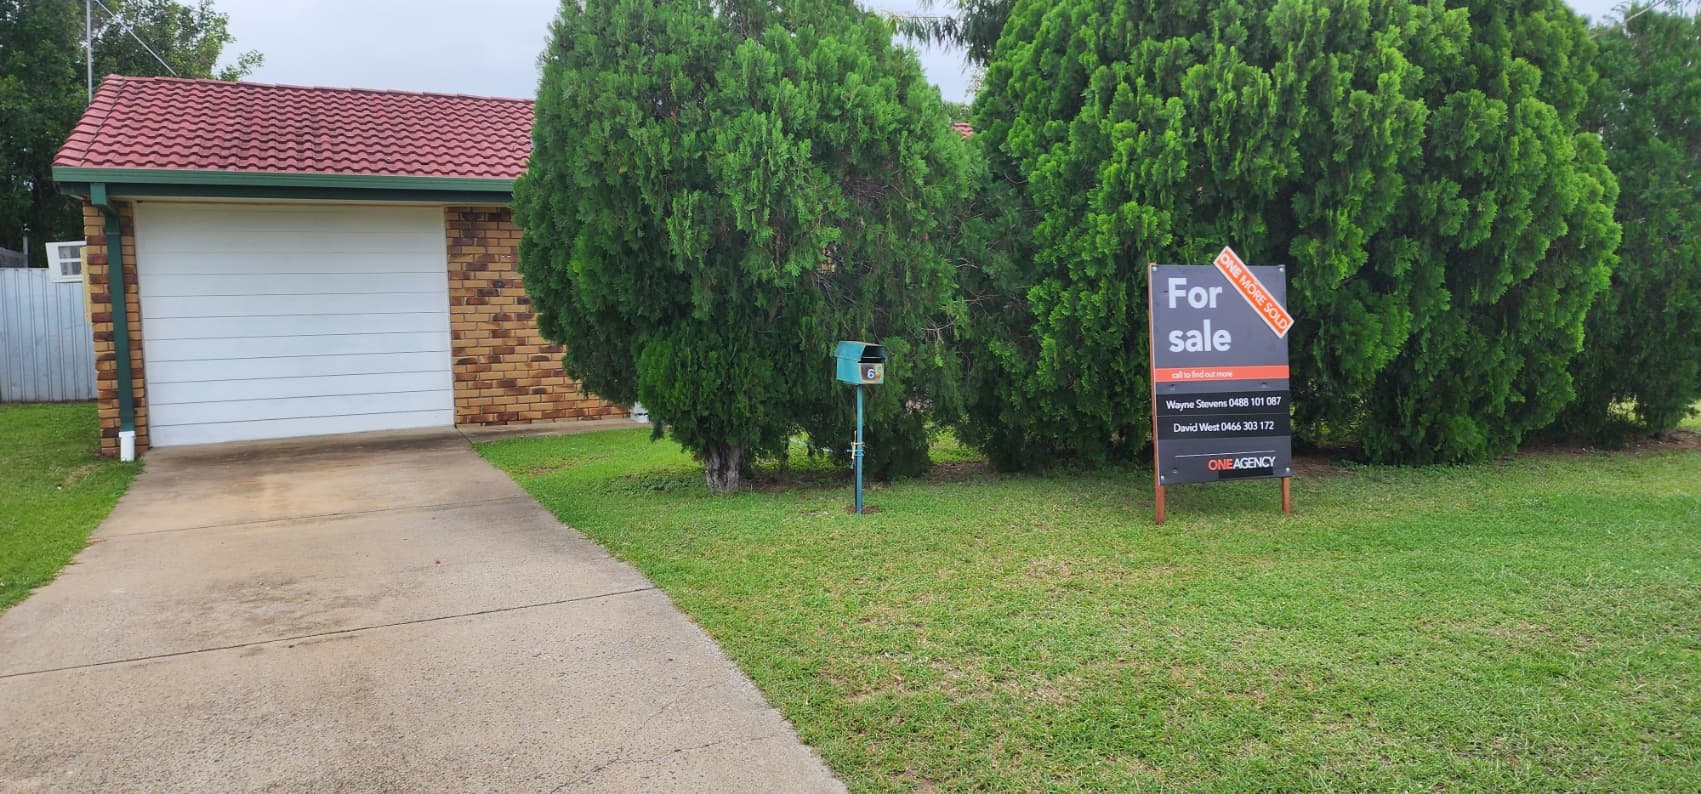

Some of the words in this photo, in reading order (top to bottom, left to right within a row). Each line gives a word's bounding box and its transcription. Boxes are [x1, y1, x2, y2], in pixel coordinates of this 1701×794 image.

[1168, 277, 1222, 309] For
[1220, 253, 1241, 278] ONE
[1240, 276, 1266, 305] MORE
[1264, 303, 1288, 331] SOLD
[1169, 319, 1231, 352] sale
[1166, 400, 1194, 412] Wayne
[1196, 399, 1227, 409] Stevens
[1229, 398, 1249, 407] 0488
[1251, 397, 1264, 406] 101
[1266, 396, 1281, 406] 087
[1174, 423, 1198, 433] David
[1200, 423, 1219, 432] West
[1221, 422, 1241, 431] 0466
[1243, 422, 1258, 430] 303
[1260, 421, 1274, 430] 172
